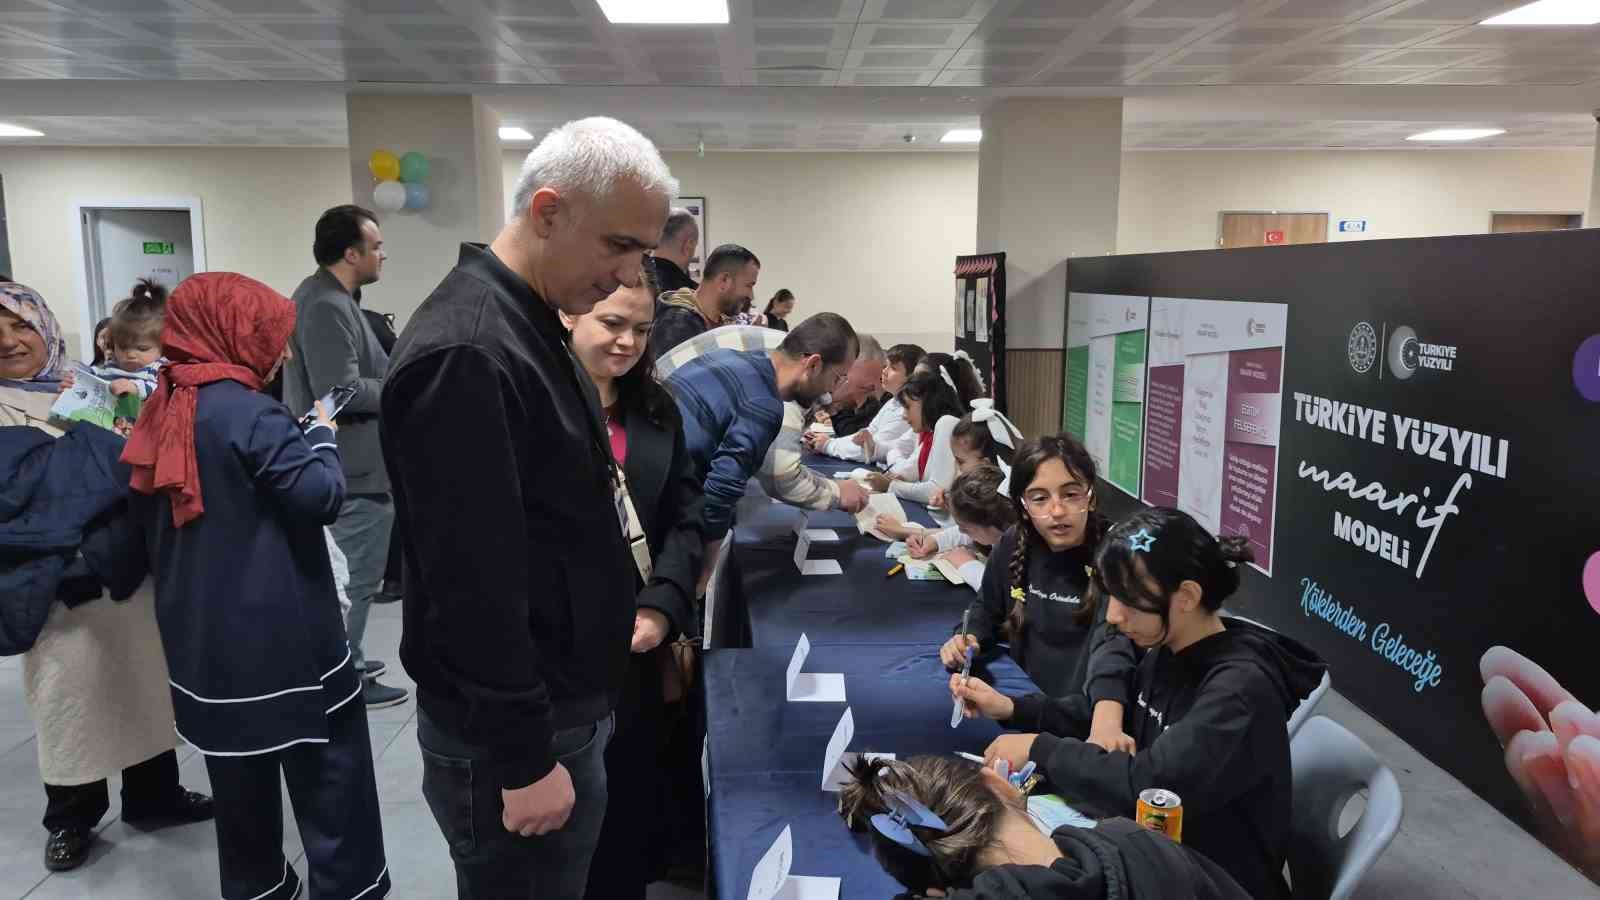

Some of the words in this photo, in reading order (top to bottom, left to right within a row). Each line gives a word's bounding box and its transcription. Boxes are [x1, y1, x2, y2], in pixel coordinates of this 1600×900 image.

[1294, 392, 1387, 444] TÜRKİYE
[1393, 414, 1509, 479] YÜZYILI
[1299, 460, 1472, 578] maarif
[1333, 511, 1410, 568] MODELİ
[1300, 577, 1367, 641] Köklerden
[1371, 622, 1441, 692] Geleceğe
